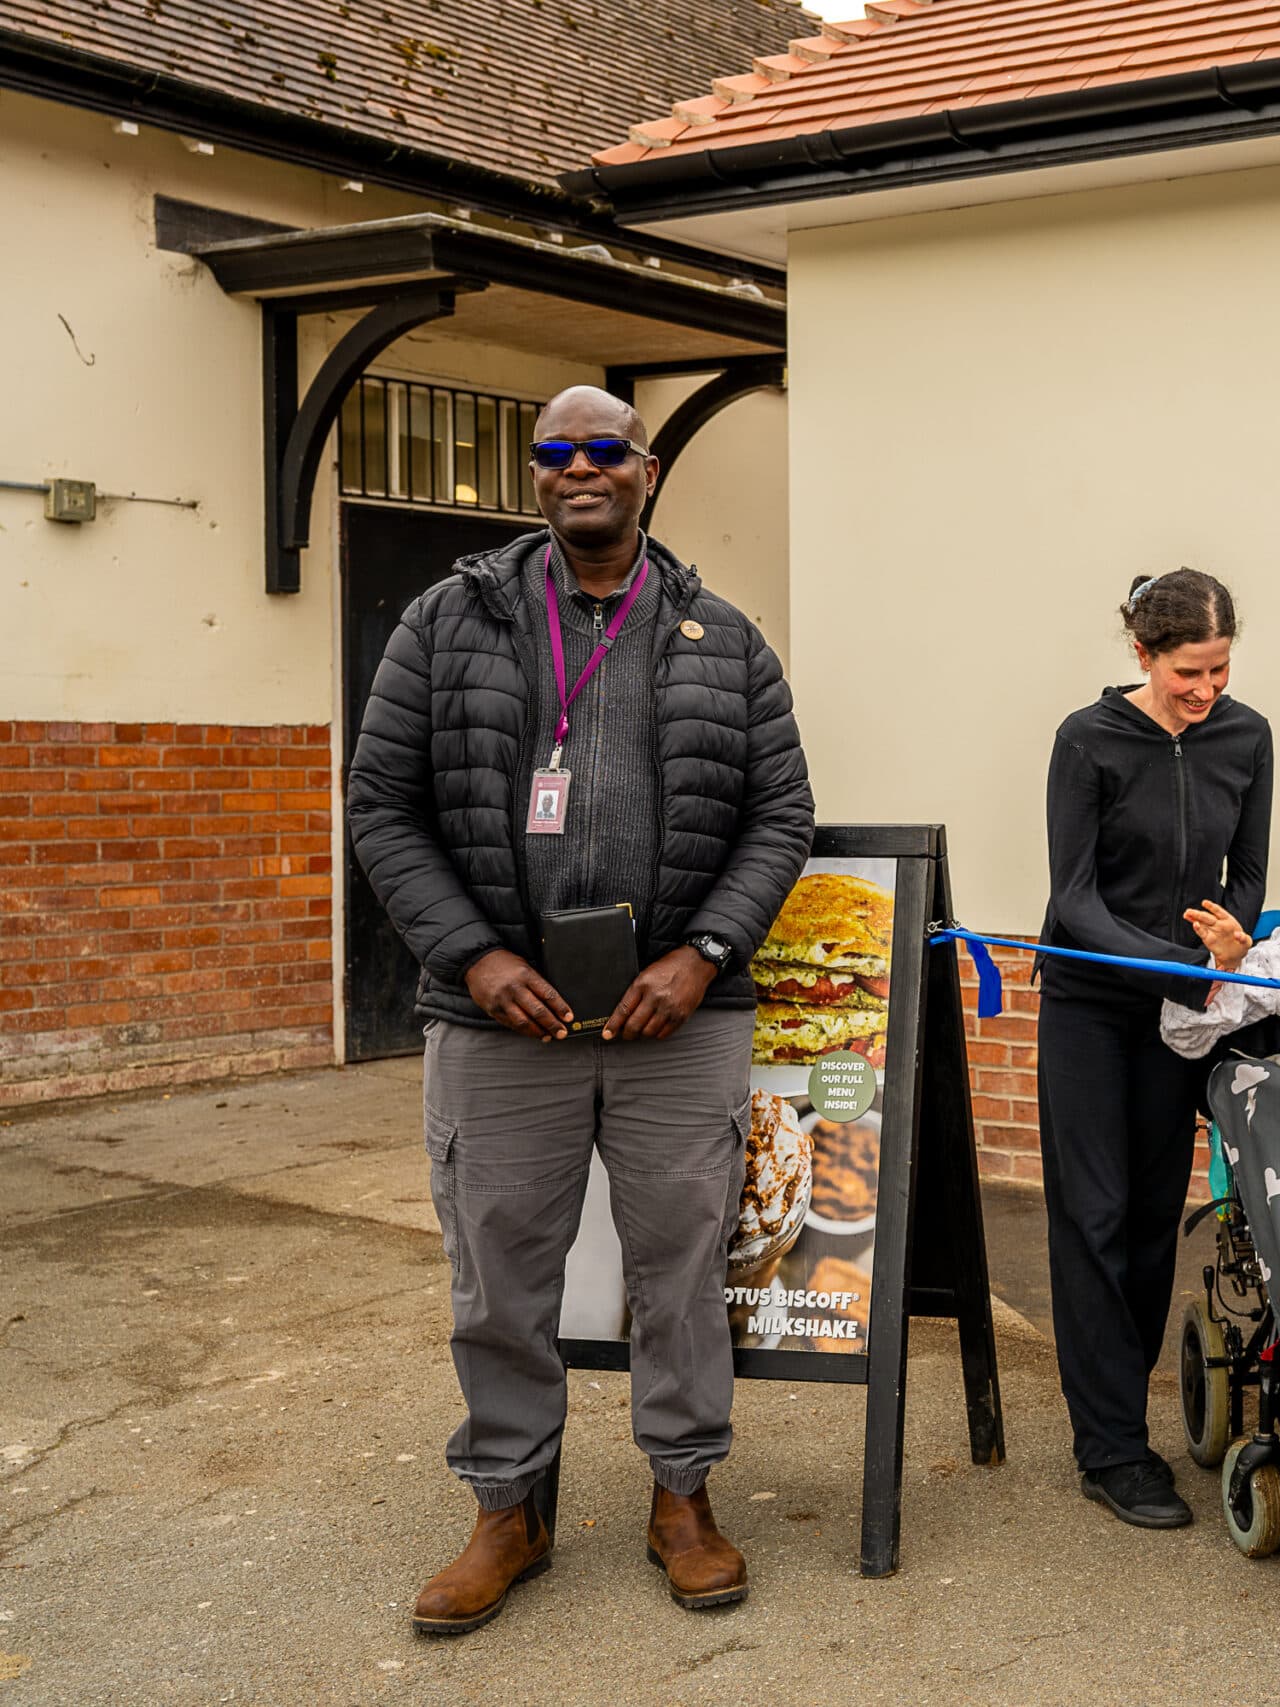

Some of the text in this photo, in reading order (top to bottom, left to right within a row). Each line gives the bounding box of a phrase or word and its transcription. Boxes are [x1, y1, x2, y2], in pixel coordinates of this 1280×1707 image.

[821, 1061, 865, 1071] DISCOVER
[821, 1075, 864, 1084] OUR FULL
[828, 1087, 856, 1097] MENU
[824, 1100, 858, 1110] INSIDE!
[724, 1287, 771, 1306] OTUS
[747, 1316, 858, 1339] MILKSHAKE
